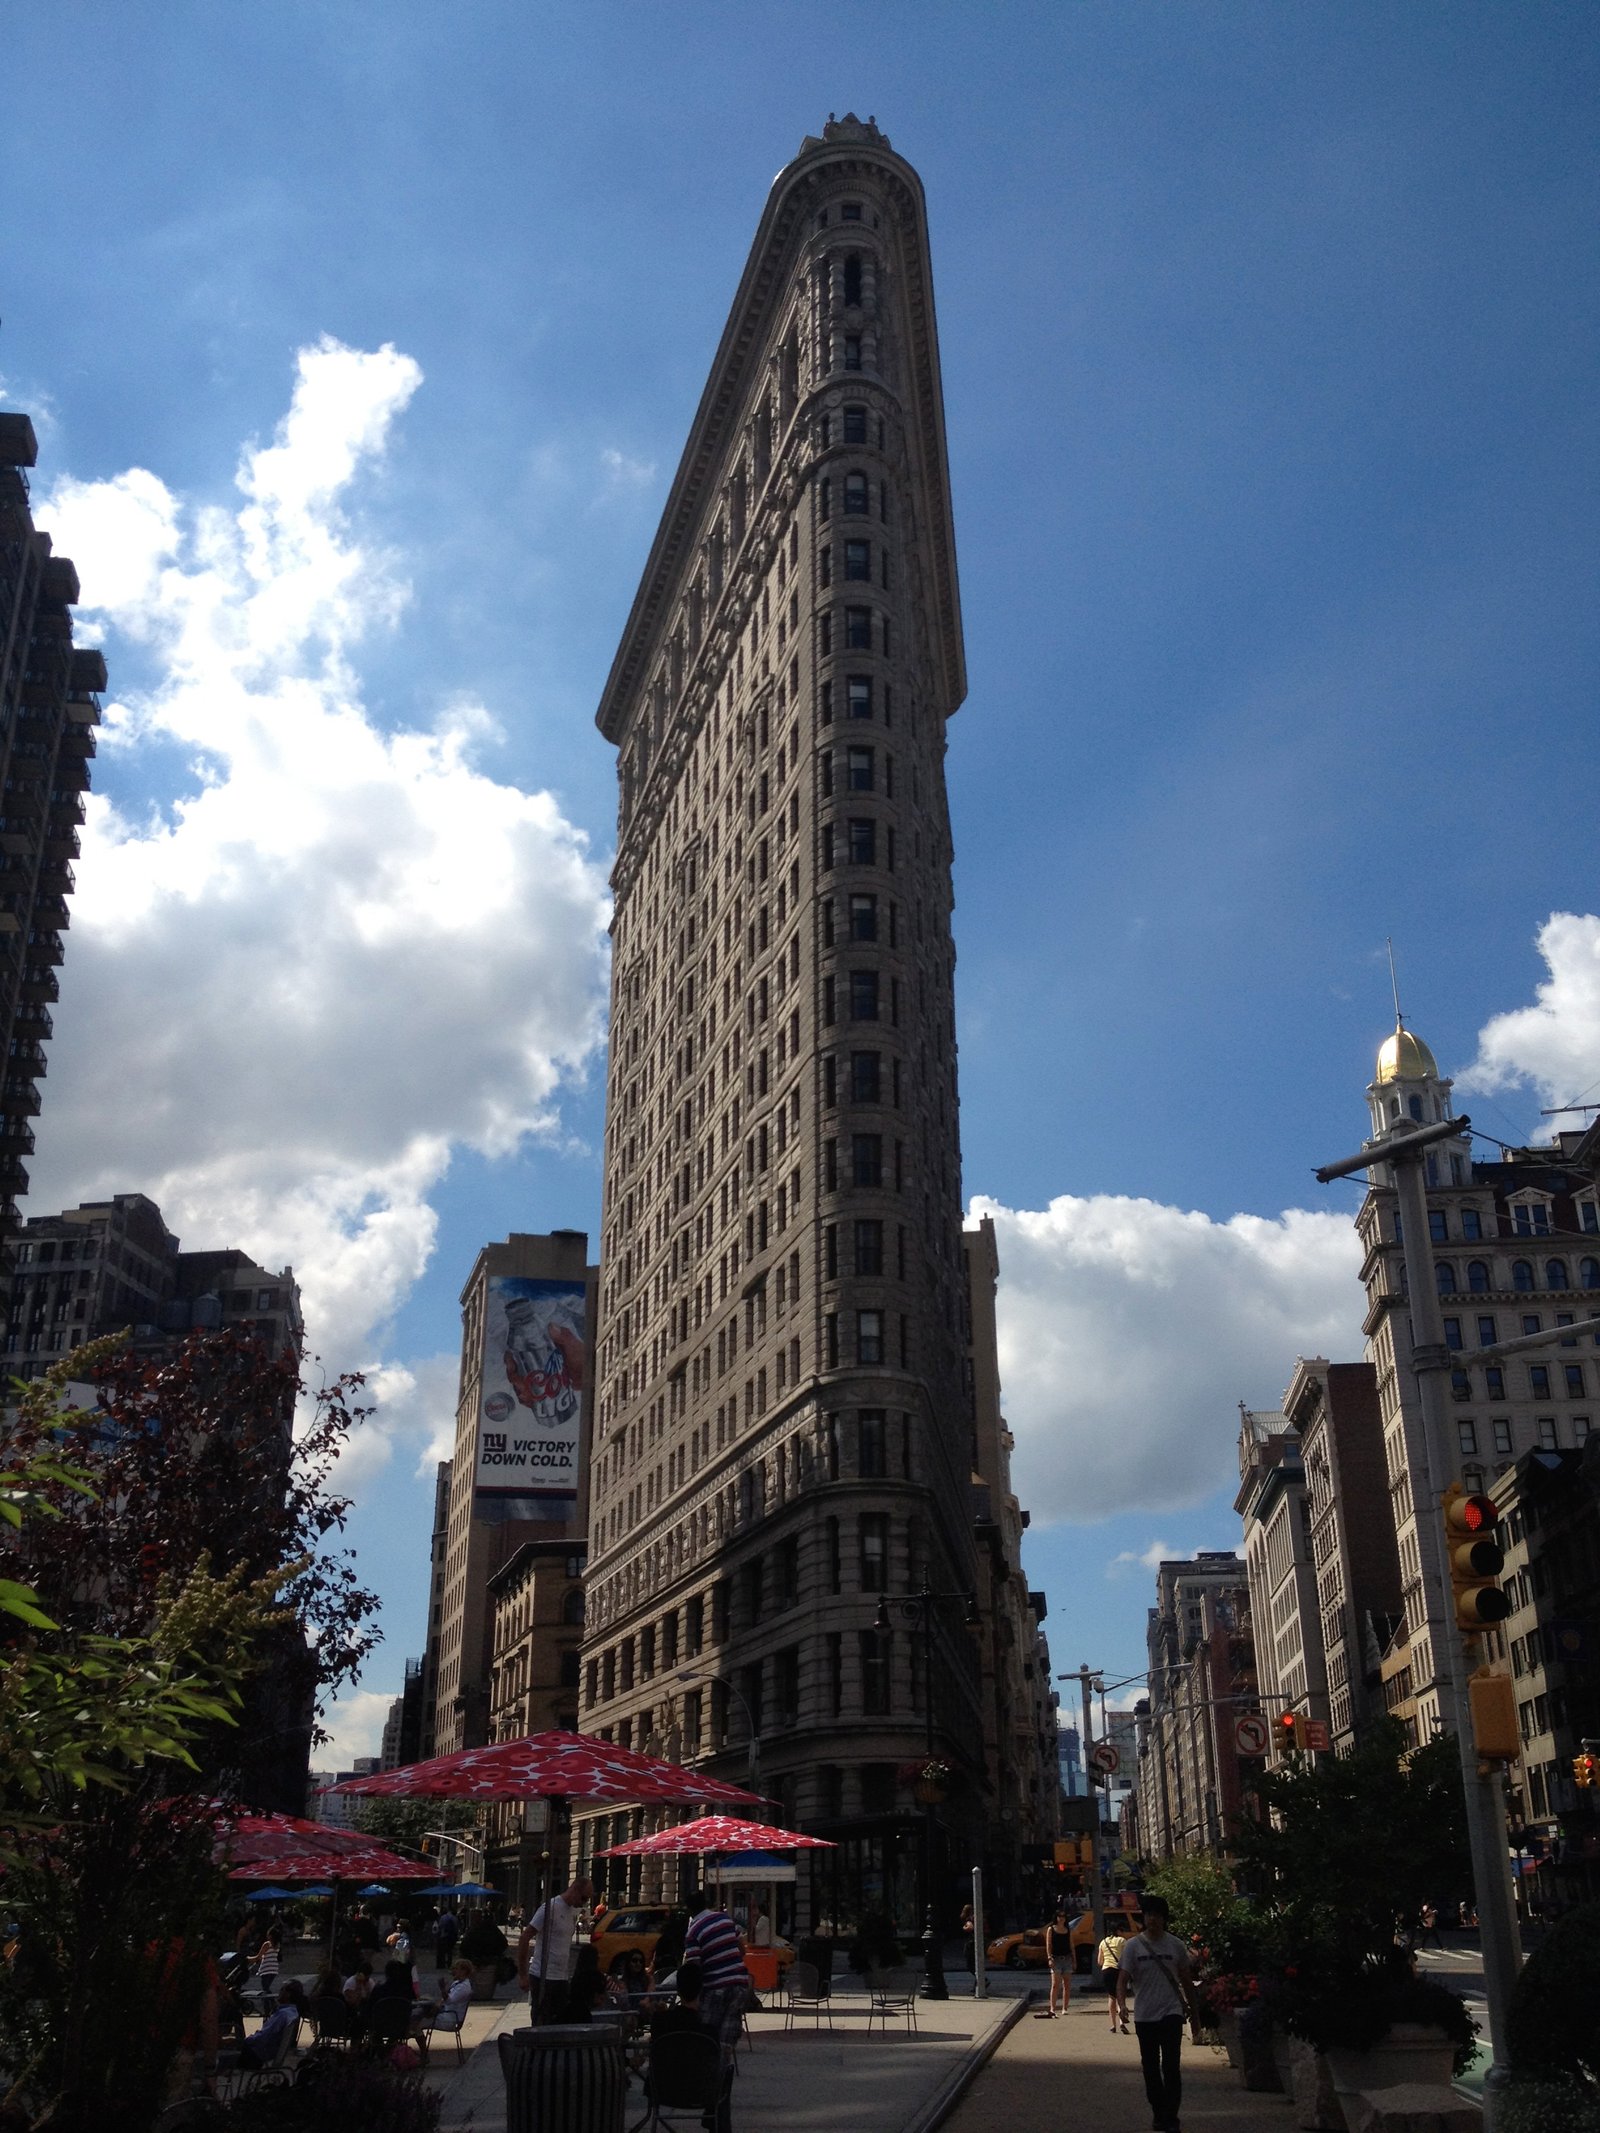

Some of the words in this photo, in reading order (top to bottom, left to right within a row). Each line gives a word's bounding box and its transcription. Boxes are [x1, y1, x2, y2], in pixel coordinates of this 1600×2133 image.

[514, 1440, 576, 1453] VICTORY
[482, 1453, 526, 1466] DOWN
[530, 1455, 573, 1467] COLD.
